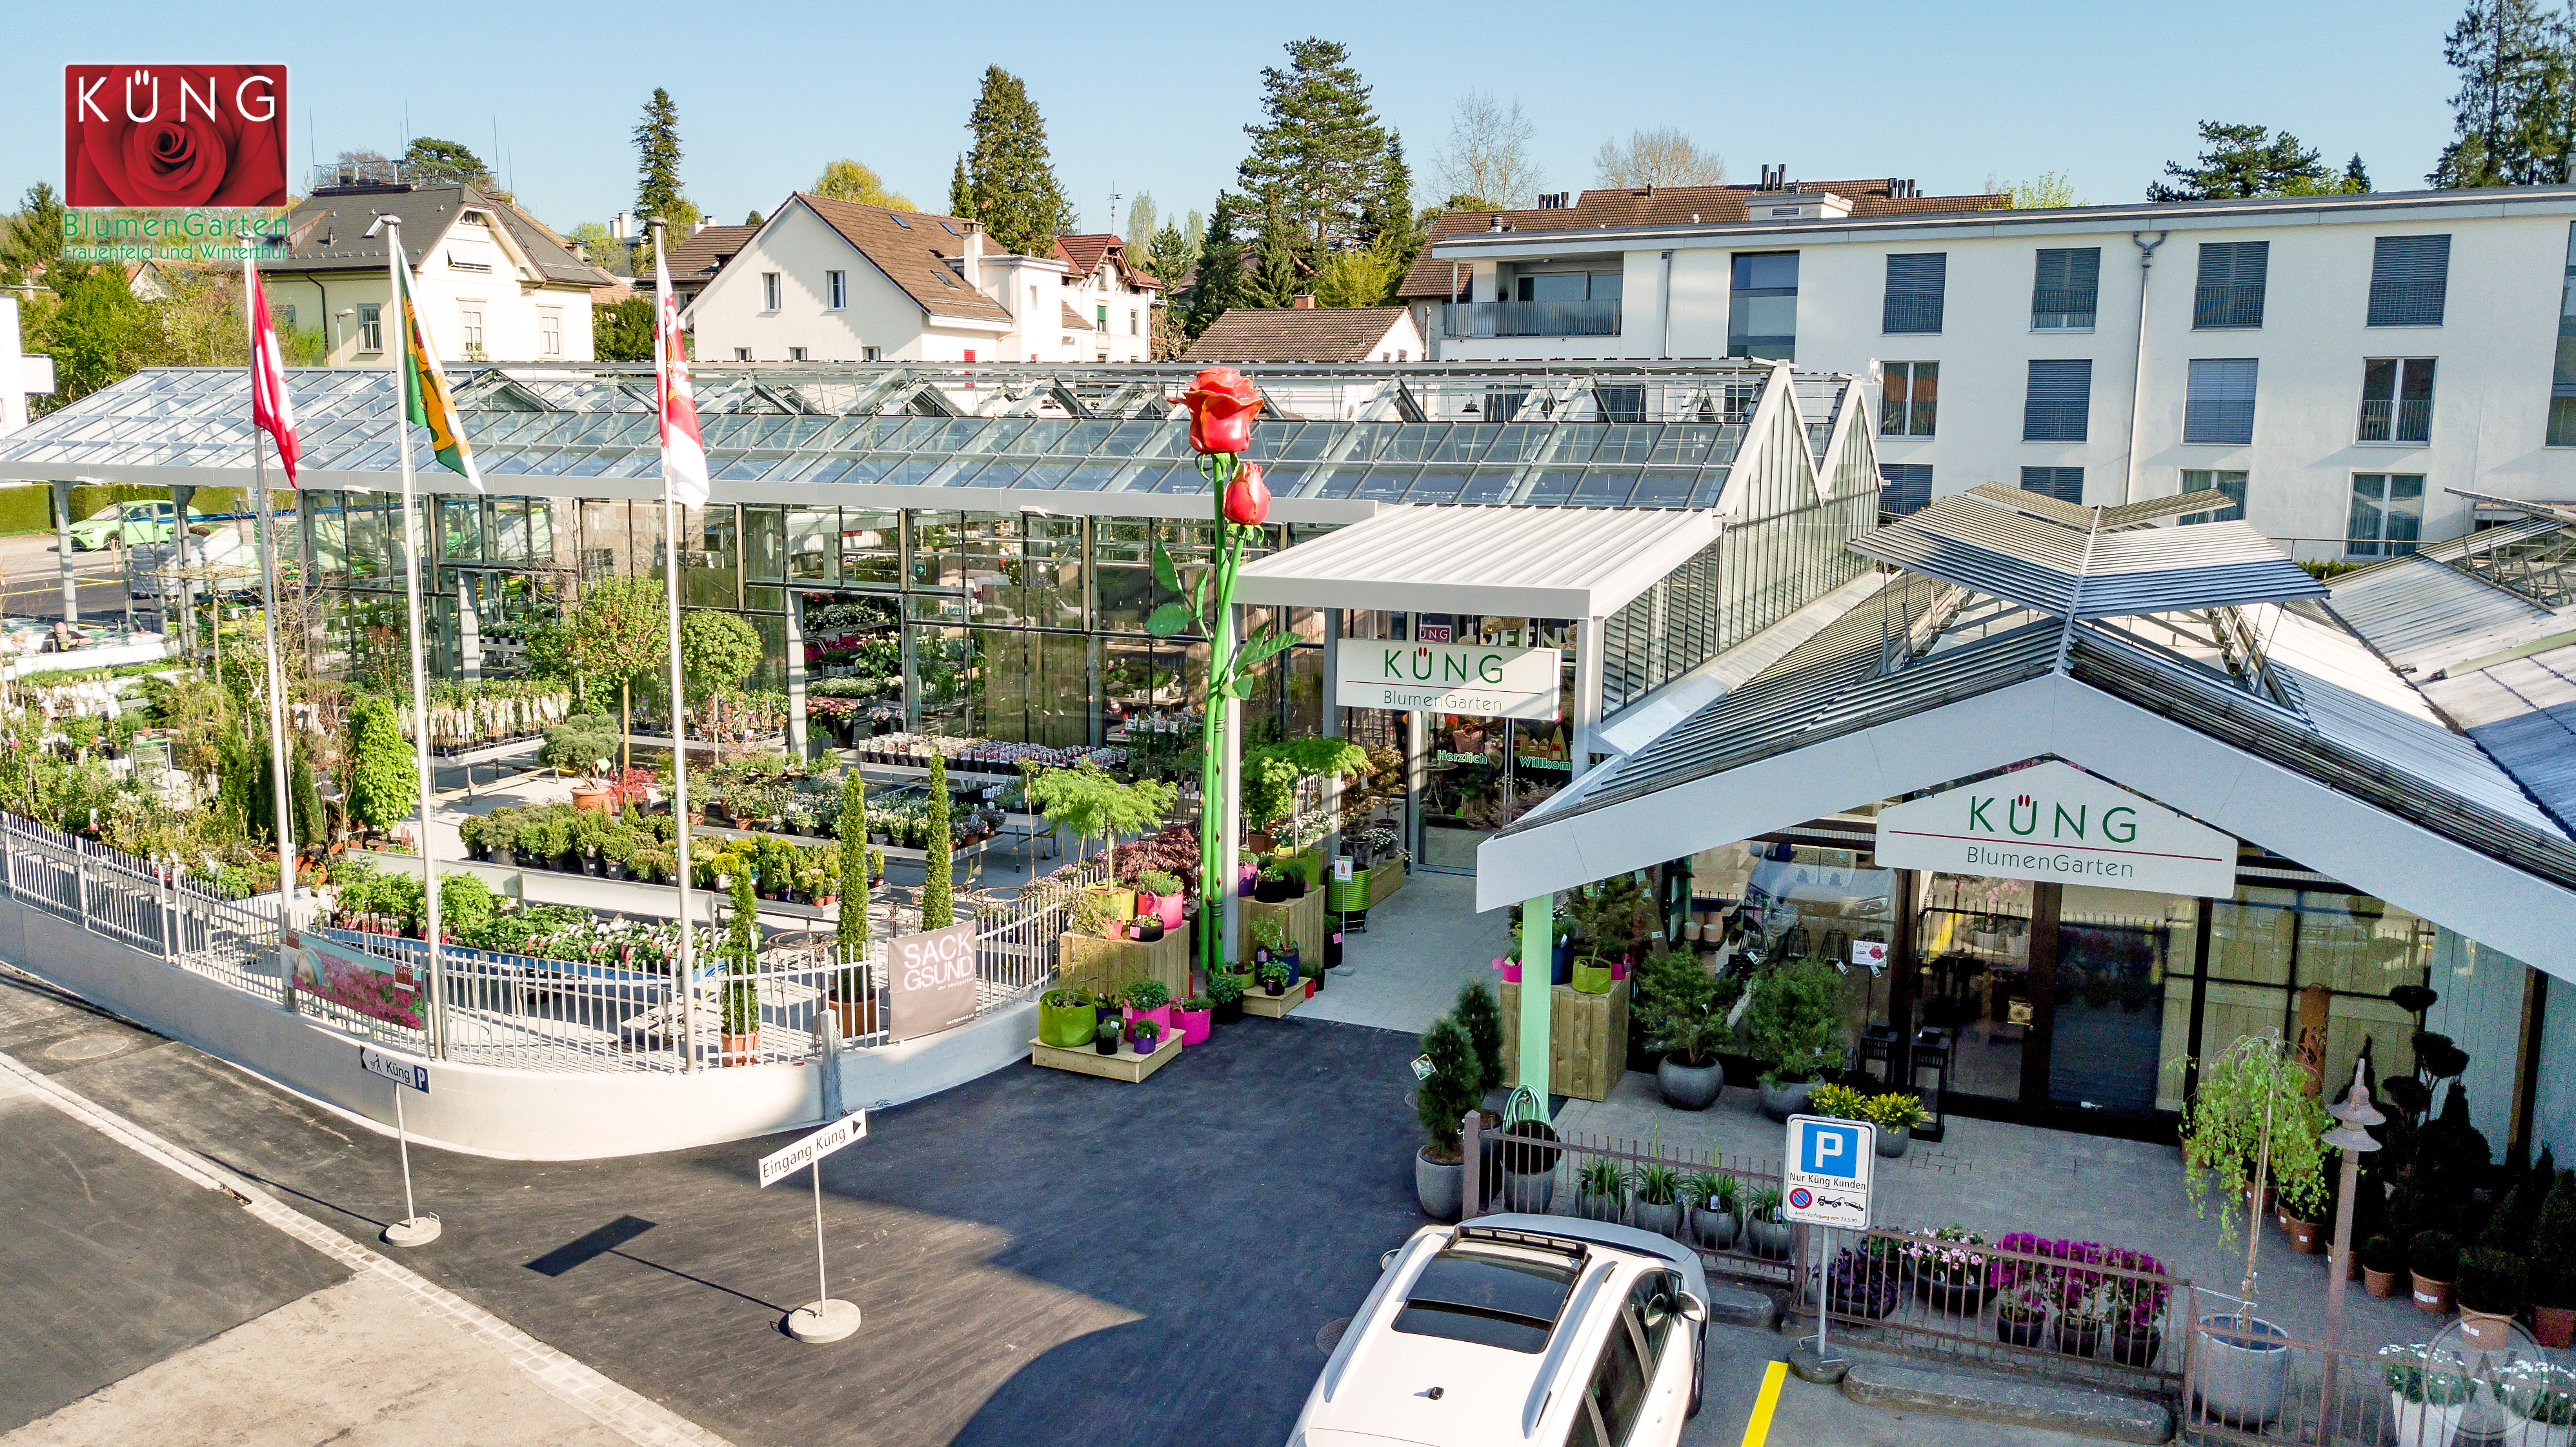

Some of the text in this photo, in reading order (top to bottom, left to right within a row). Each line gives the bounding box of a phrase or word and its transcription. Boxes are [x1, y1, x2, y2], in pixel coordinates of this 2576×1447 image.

[1420, 627, 1448, 640] ÜNG
[1384, 647, 1503, 683] KÜNG
[1384, 690, 1502, 711] BlumenGarten
[1437, 749, 1573, 771] Herzlich Willkom
[1969, 794, 2137, 843] KÜNG
[1967, 846, 2133, 878] BlumenGarten
[904, 929, 973, 969] SACK
[904, 956, 973, 991] GSUND
[386, 1060, 425, 1088] Küng P
[763, 1128, 845, 1178] Eingang Küng
[1815, 1131, 1843, 1168] P
[1789, 1172, 1866, 1190] Nur Küng Kunden
